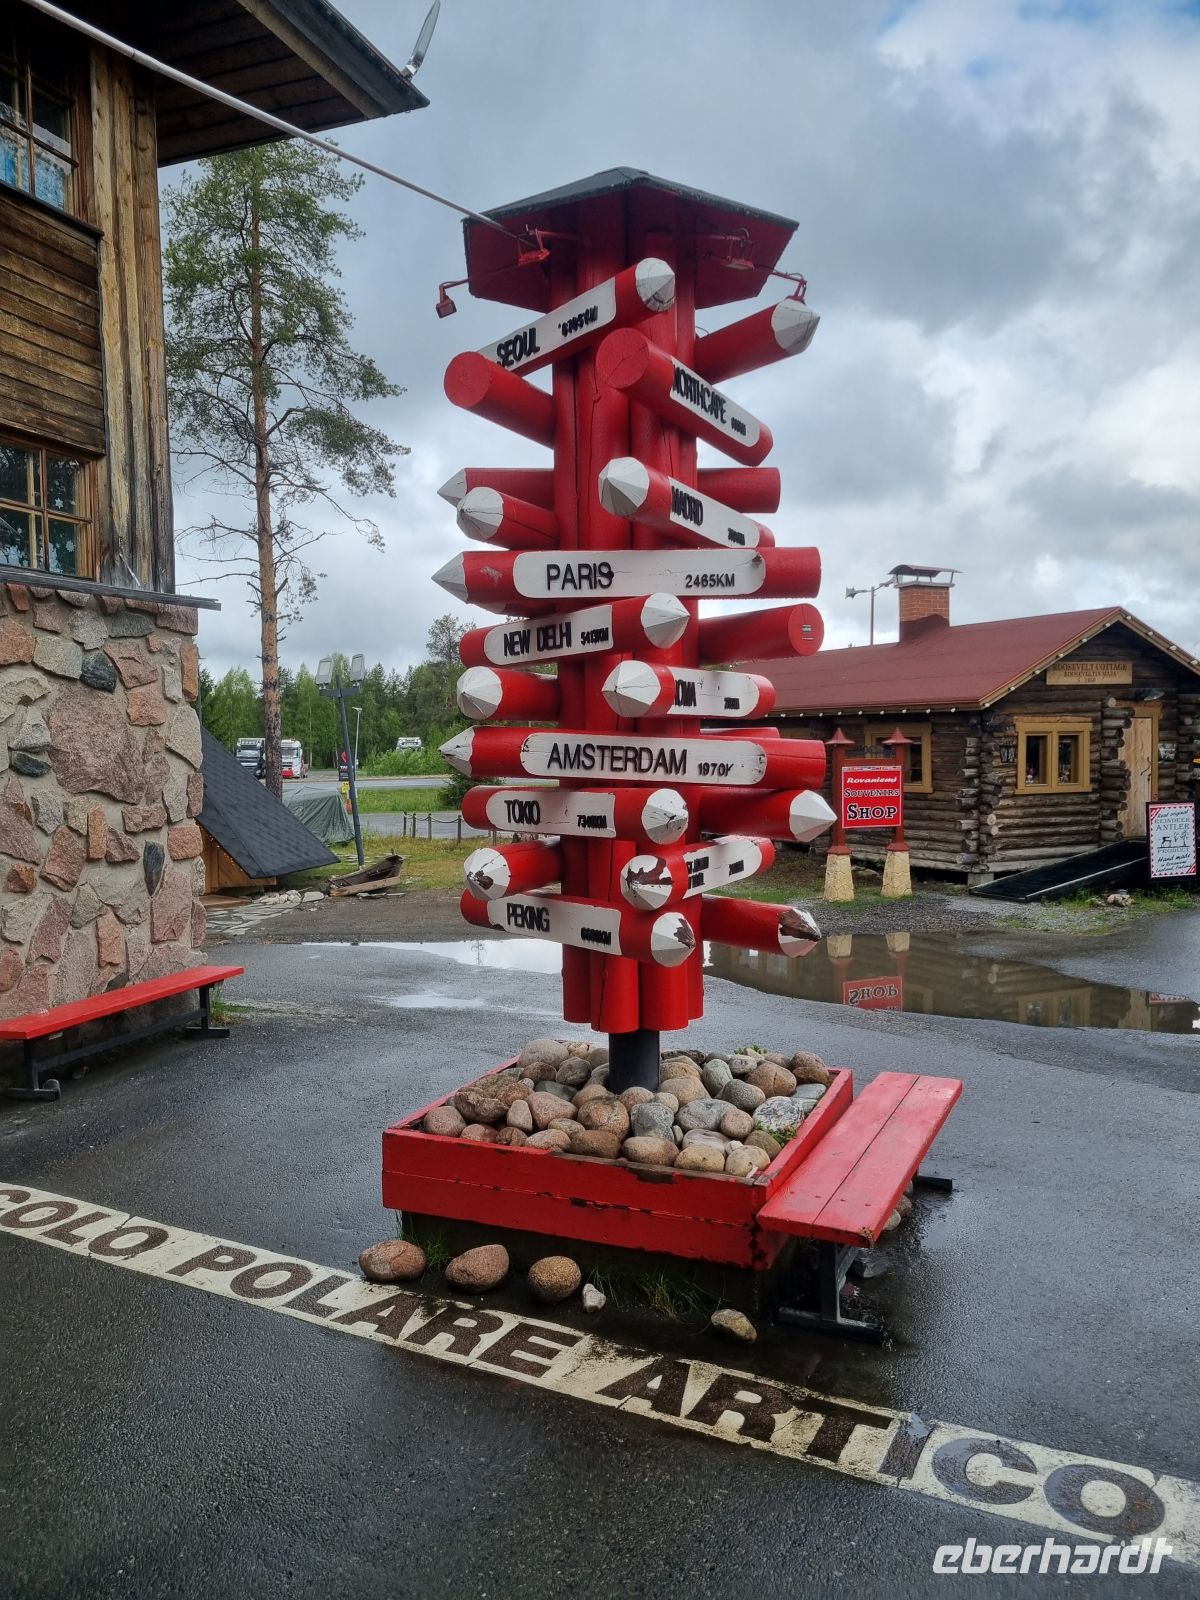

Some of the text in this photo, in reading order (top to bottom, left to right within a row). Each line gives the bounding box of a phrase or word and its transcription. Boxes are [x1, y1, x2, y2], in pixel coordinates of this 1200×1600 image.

[496, 327, 541, 368] SEOUL
[546, 561, 736, 591] PARIS 2465KM
[503, 629, 531, 657] NEW
[547, 742, 688, 776] AMSTERDAM
[846, 776, 898, 784] Rovaniemi
[504, 799, 541, 826] TOKIO
[847, 802, 898, 820] SHOP
[1155, 817, 1191, 825] REINDEER
[1156, 823, 1190, 831] ANTLER
[506, 902, 550, 933] PEKING
[165, 1244, 586, 1379] POLARE
[595, 1357, 1166, 1537] ARTICO
